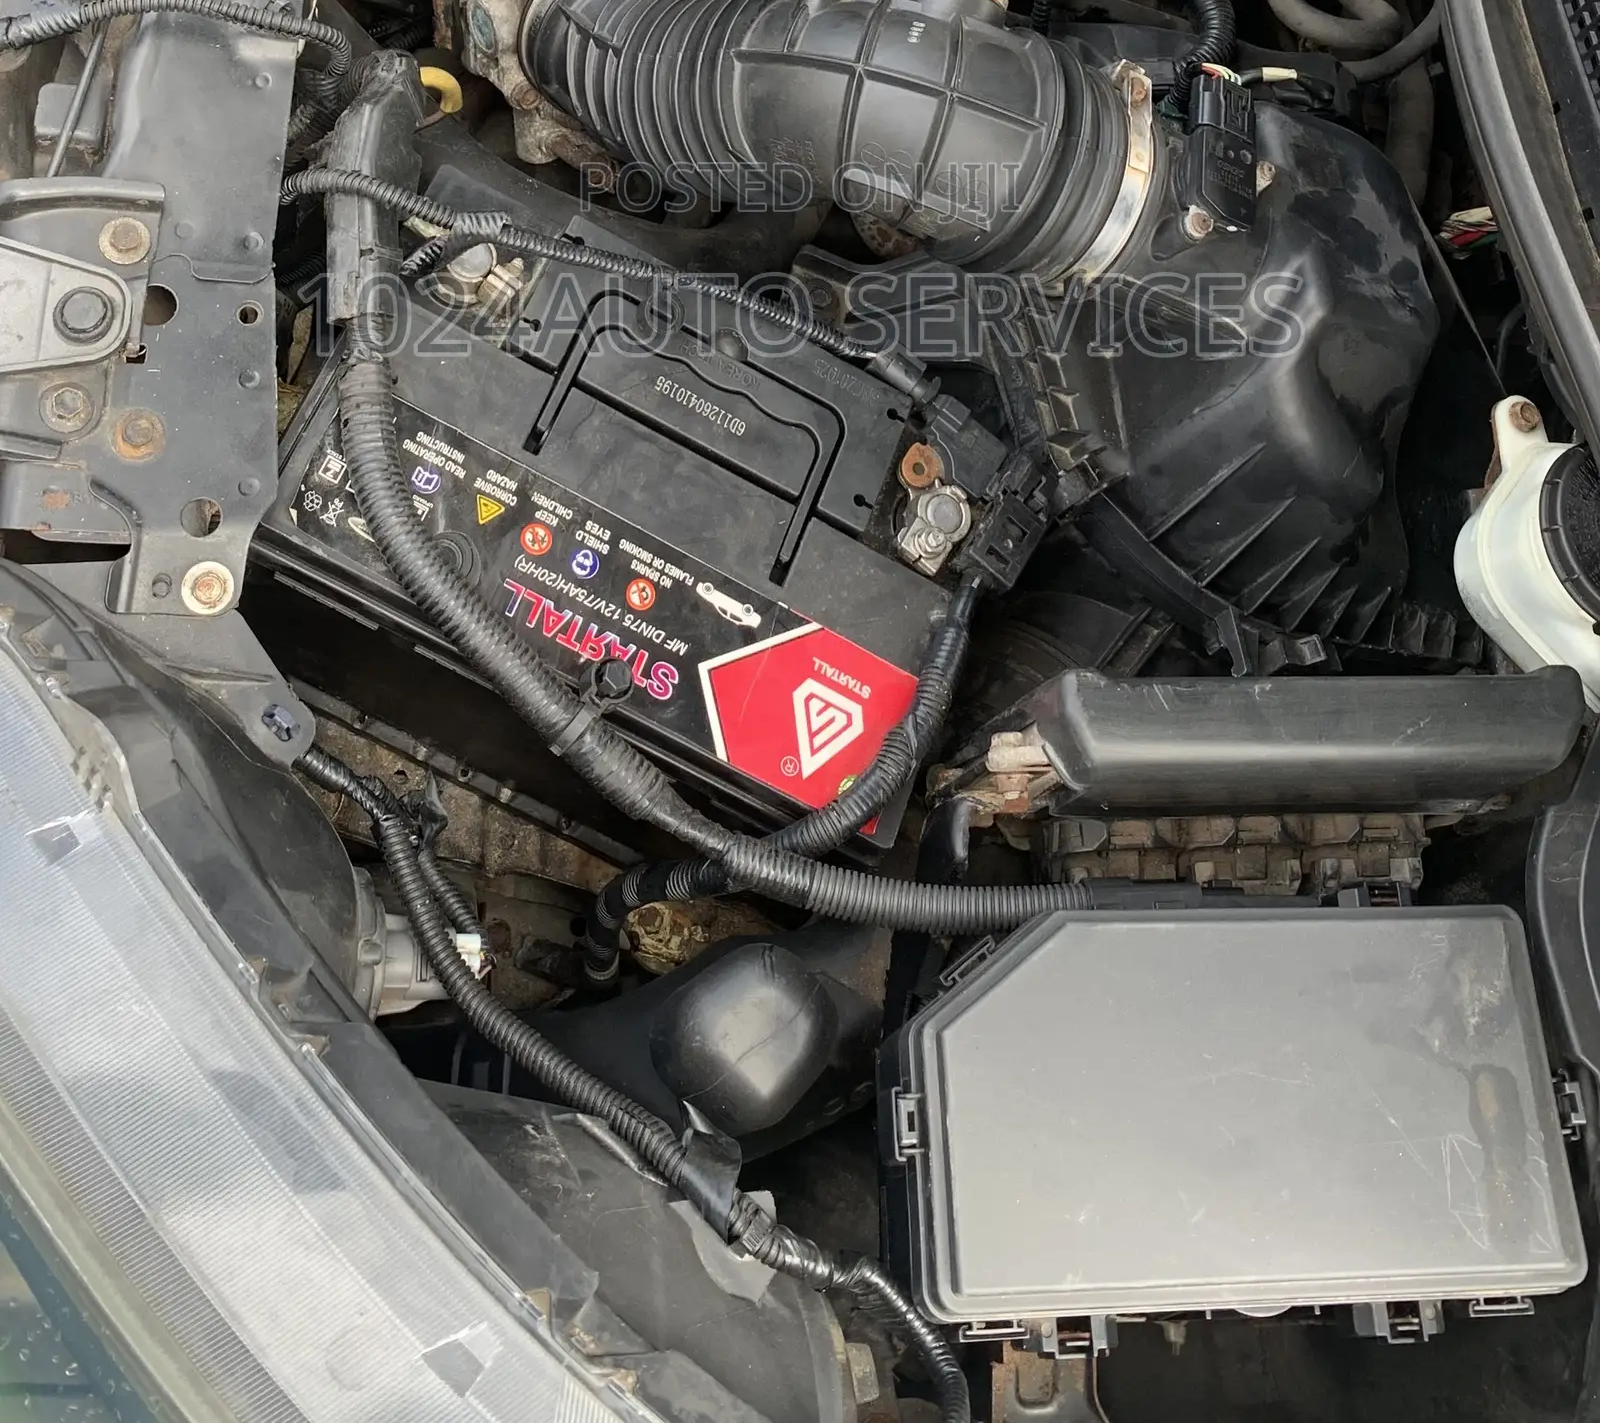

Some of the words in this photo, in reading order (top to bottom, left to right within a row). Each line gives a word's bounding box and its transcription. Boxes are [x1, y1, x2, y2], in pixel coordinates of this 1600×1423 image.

[654, 376, 747, 437] 6D11260410195
[402, 438, 446, 468] OPERATING
[416, 431, 465, 463] INSTRUCTING
[444, 460, 467, 478] READ
[485, 469, 518, 491] HAZARD
[473, 477, 518, 506] CORROSIVE
[530, 491, 573, 520] CHILDREN
[534, 508, 559, 526] KEEP
[575, 529, 610, 554] SHIELD
[585, 520, 611, 540] EYES
[618, 538, 652, 563] SMOKING
[651, 556, 665, 569] OR
[630, 559, 660, 581] SPARKS
[659, 575, 673, 587] NO
[661, 562, 695, 585] FLAMES
[514, 553, 622, 621] 12V/75AH(20HR)
[503, 578, 679, 701] STARTALL
[622, 614, 666, 644] DIN75
[664, 636, 689, 656] MF
[812, 656, 871, 699] STARTALL
